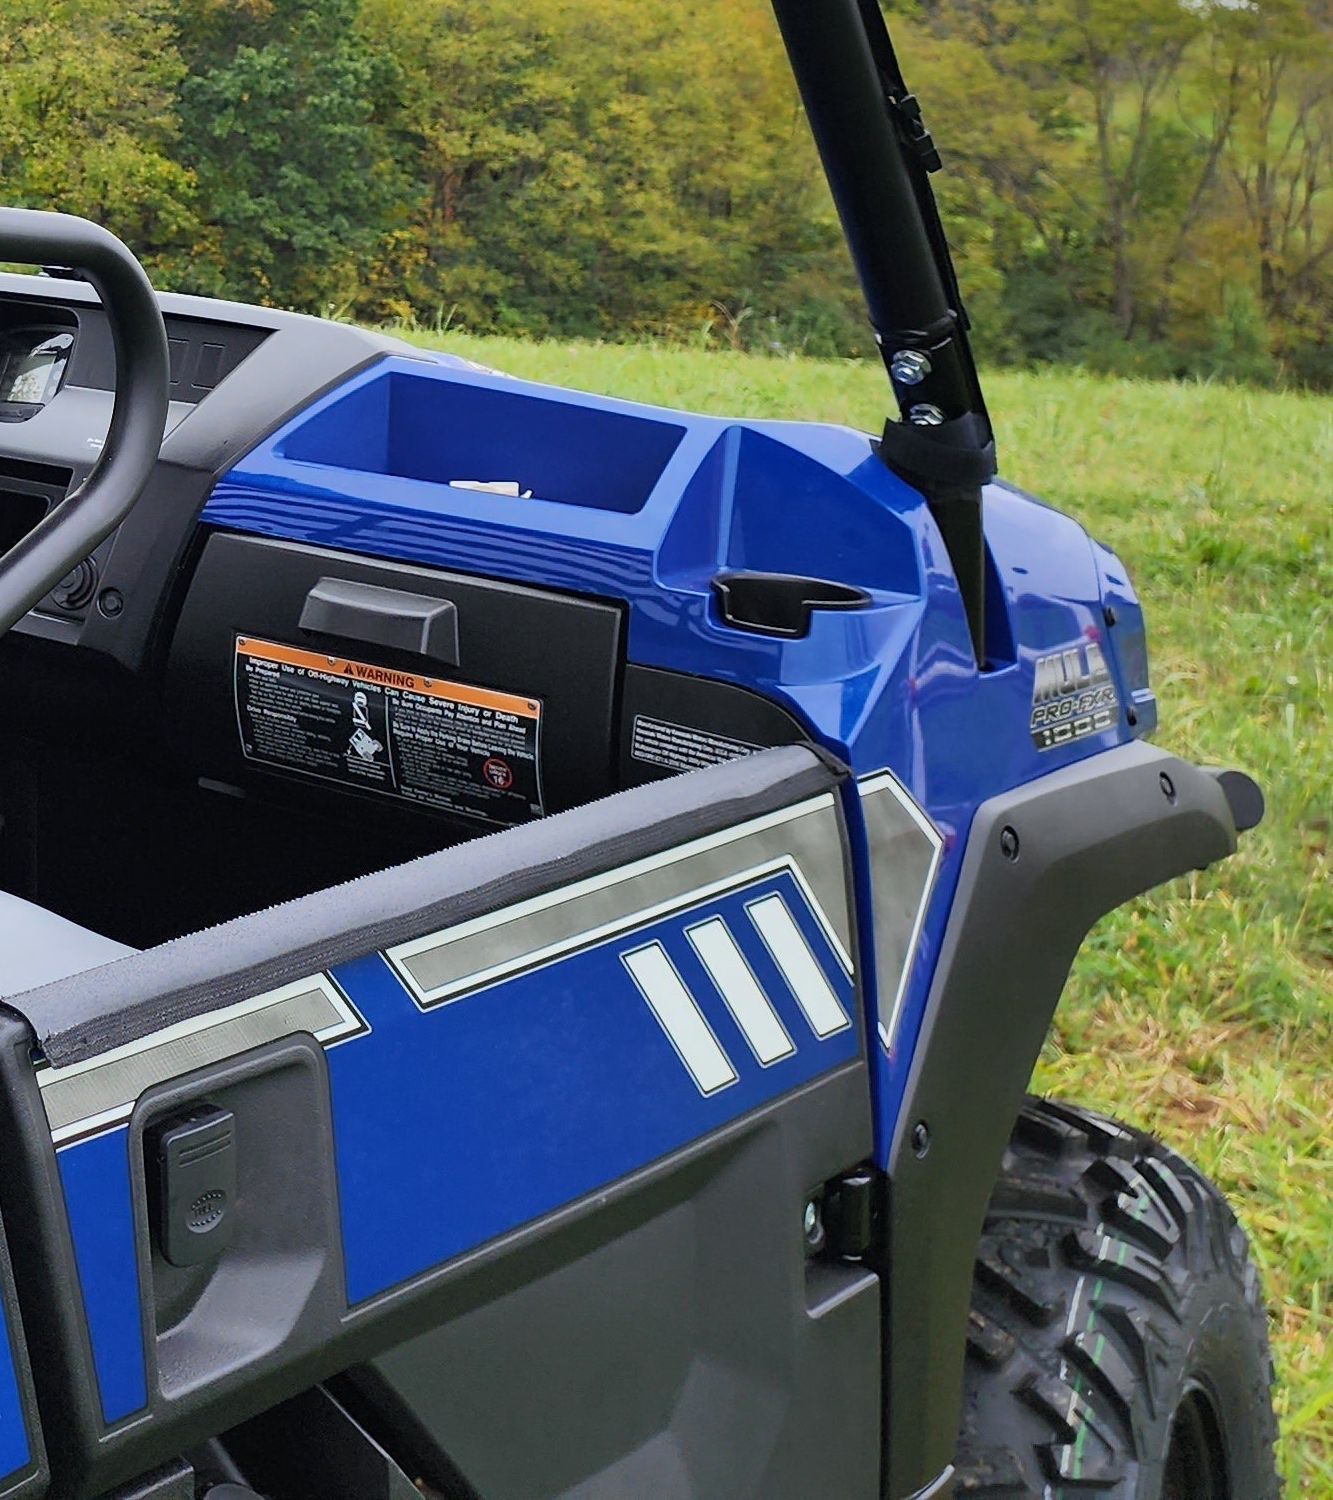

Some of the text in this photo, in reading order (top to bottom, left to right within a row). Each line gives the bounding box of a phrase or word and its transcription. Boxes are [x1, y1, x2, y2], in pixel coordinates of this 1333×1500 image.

[250, 656, 279, 669] Improper
[281, 664, 294, 673] Use
[307, 670, 349, 687] Off-Highway
[352, 680, 381, 693] Vehicles
[384, 687, 399, 697] Can
[402, 691, 426, 703] Cause
[429, 696, 454, 709] Severe
[458, 703, 480, 716] Injury
[495, 711, 518, 724] Death
[356, 665, 414, 688] WARNING
[1031, 684, 1117, 729] PRO-FXR
[1043, 711, 1110, 745] 1000
